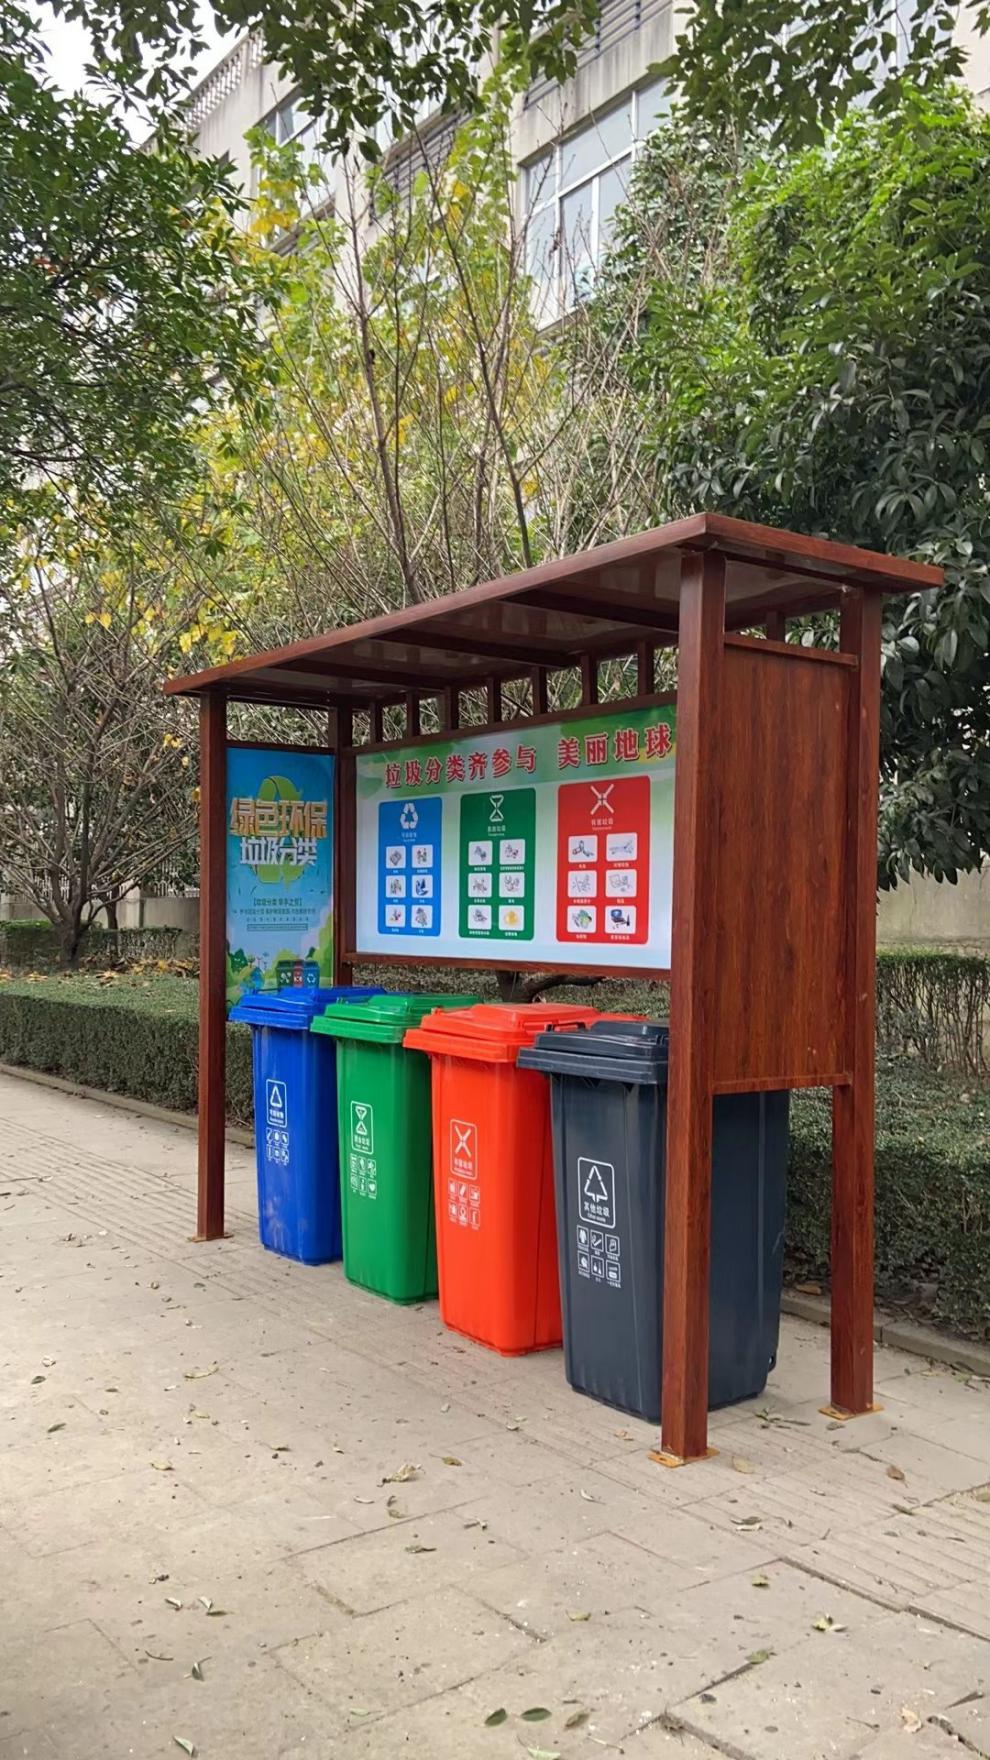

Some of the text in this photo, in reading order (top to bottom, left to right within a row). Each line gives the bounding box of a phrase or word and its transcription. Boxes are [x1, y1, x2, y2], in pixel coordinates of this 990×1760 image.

[384, 723, 673, 788] 垃圾分类齐参与 美丽地球
[229, 797, 328, 838] 绿色环保
[239, 837, 318, 866] 垃圾分类
